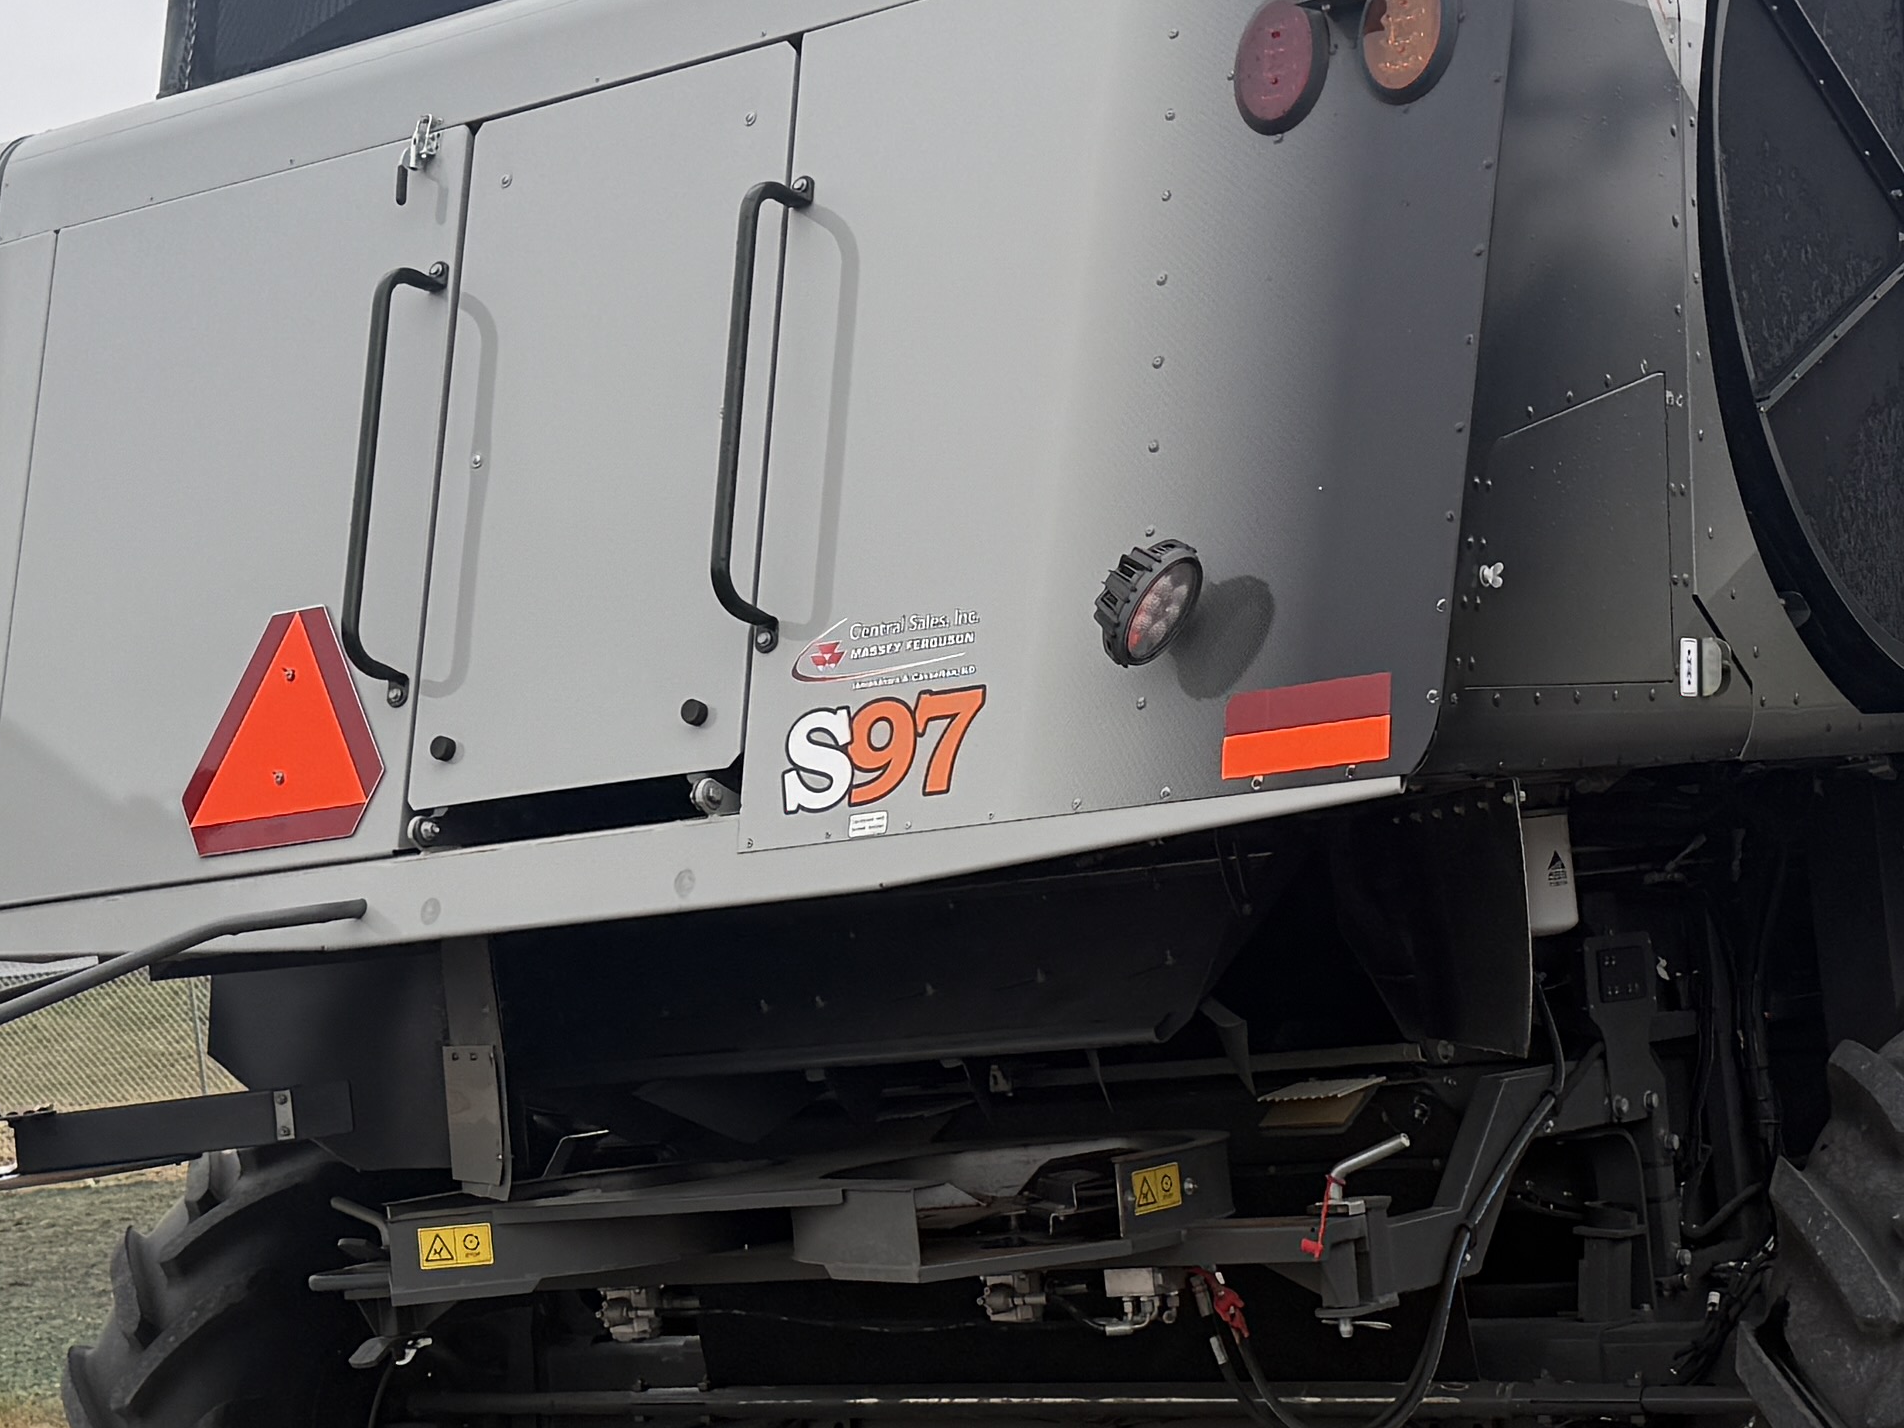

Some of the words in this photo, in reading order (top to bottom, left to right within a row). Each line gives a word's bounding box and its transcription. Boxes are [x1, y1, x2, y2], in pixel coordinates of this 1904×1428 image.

[849, 614, 905, 640] Central
[954, 608, 980, 626] Inc.
[850, 642, 902, 660] MASSEY
[906, 632, 976, 651] FERGUSON
[781, 684, 987, 815] S97
